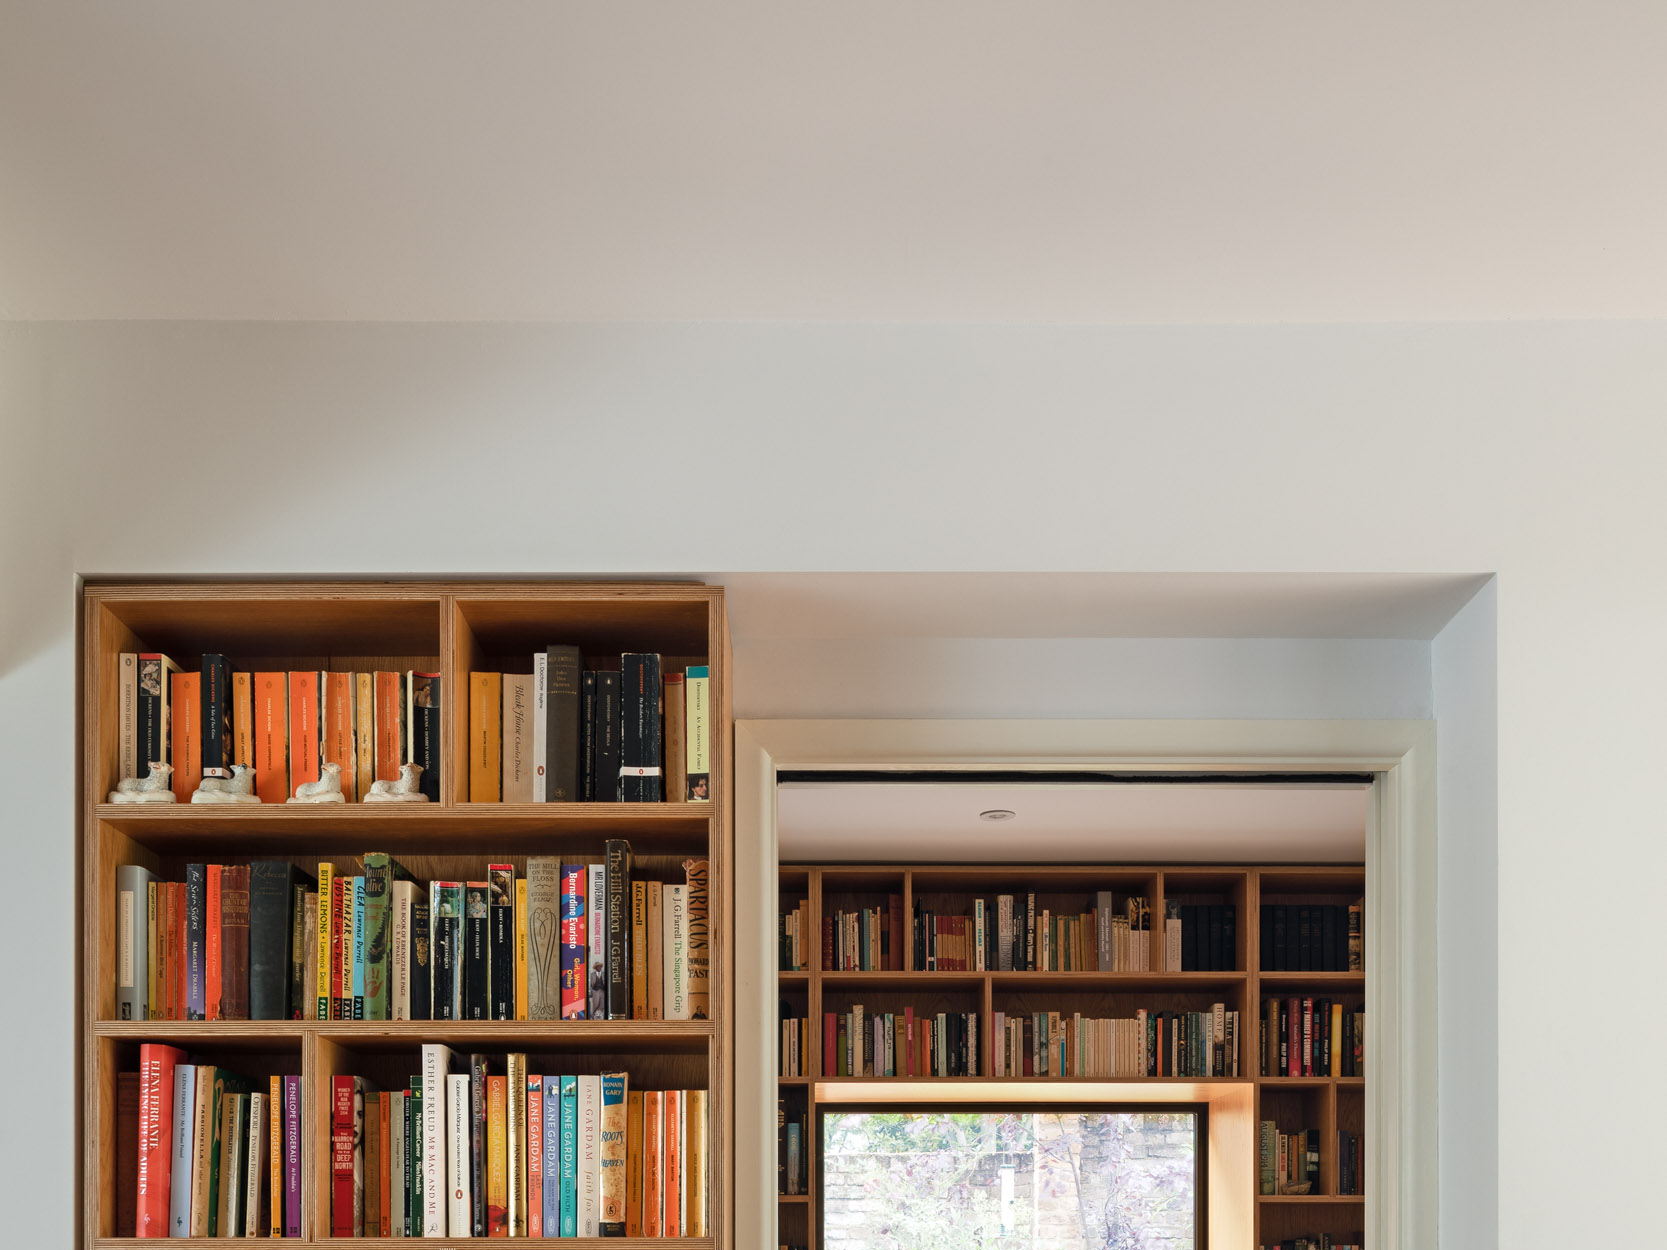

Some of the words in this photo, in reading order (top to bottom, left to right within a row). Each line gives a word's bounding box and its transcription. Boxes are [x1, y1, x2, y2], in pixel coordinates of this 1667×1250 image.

[514, 685, 524, 708] Bleak
[514, 708, 524, 735] House
[610, 849, 622, 870] The
[319, 870, 328, 896] BITTER
[568, 873, 577, 915] Bernardine
[610, 871, 622, 892] Hill
[344, 881, 352, 934] BALTHAZAR
[357, 886, 365, 906] CLEA
[690, 869, 708, 949] SPARTACUS
[319, 900, 328, 933] LEMONS
[357, 911, 365, 937] Lawrence
[610, 893, 622, 933] Station
[568, 918, 577, 948] Evaristo
[192, 942, 200, 971] MARGARET
[319, 942, 328, 968] Lawrence
[344, 938, 352, 965] Lawrence
[357, 941, 365, 963] Durrell
[192, 974, 200, 999] DRABBLE
[319, 972, 328, 991] Durrell
[344, 969, 352, 991] Durrell
[689, 969, 709, 979] FAST
[319, 1000, 328, 1019] FABE
[150, 1060, 160, 1092] ELENA
[289, 1082, 297, 1118] PENELOPE
[531, 1095, 541, 1123] JANE
[547, 1100, 556, 1127] JANE
[149, 1095, 160, 1149] FERRANTE
[563, 1102, 572, 1129] JANE
[289, 1121, 297, 1163] FITZGERALD
[531, 1125, 541, 1173] GARDAM
[547, 1130, 556, 1176] GARDAM
[563, 1131, 572, 1178] GARDAM
[139, 1155, 147, 1194] ADULTS
